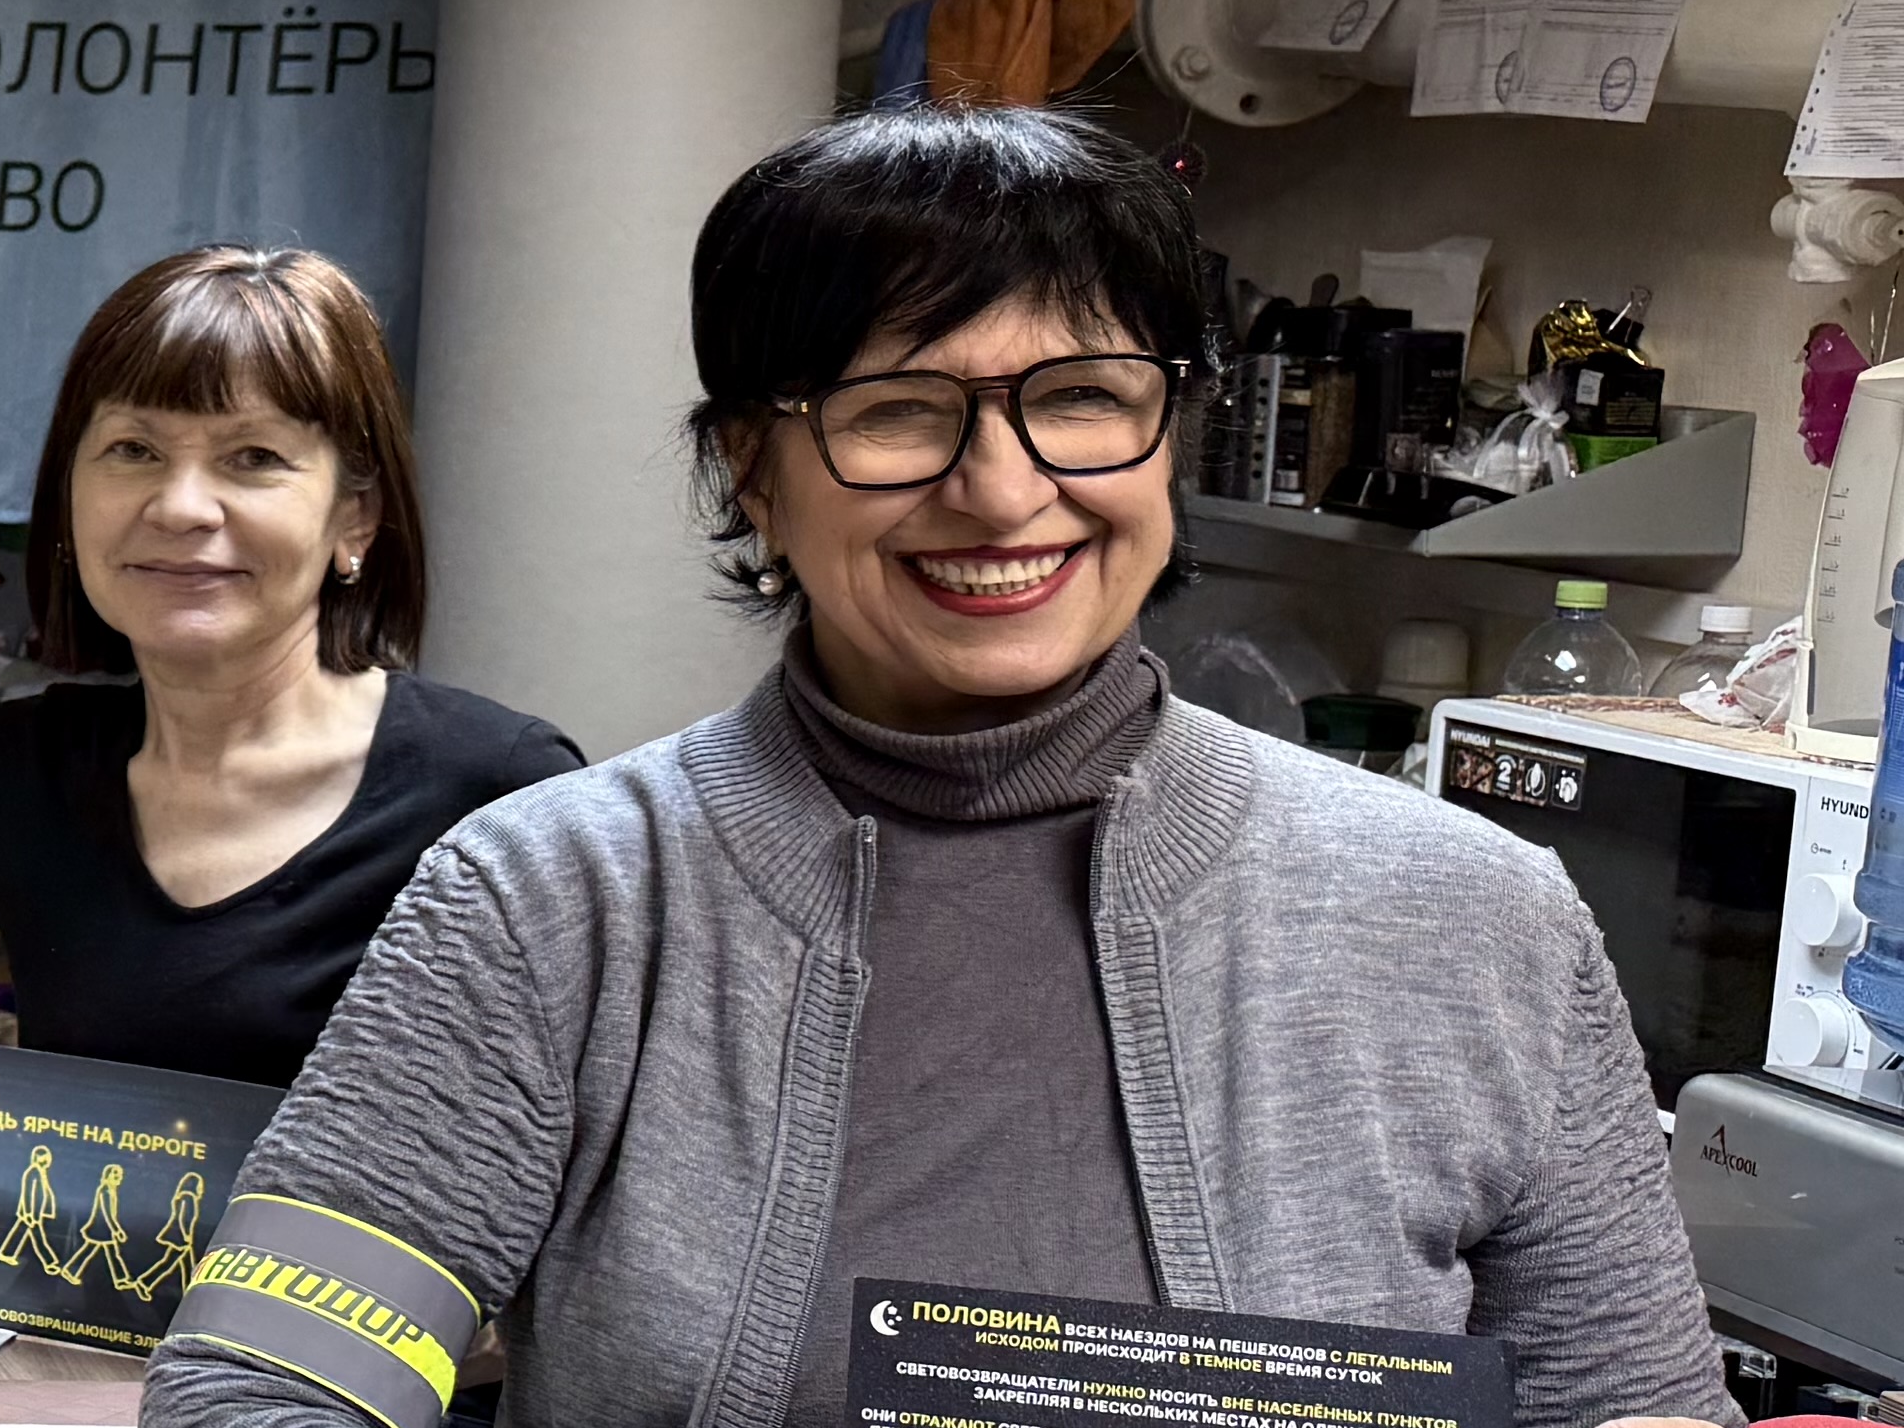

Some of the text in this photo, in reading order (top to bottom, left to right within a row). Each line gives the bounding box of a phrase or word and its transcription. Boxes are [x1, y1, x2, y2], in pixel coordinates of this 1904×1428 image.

[1820, 796, 1870, 819] HYUND
[23, 1116, 78, 1139] ЯРЧЕ
[83, 1125, 113, 1145] НА
[118, 1131, 207, 1160] ДОРОГЕ
[209, 1249, 426, 1349] АВТОДОР
[912, 1301, 1452, 1375] ПОЛОВИНА ВСЕХ НАЕЗДОВ НА ПЕШЕХОДОВ С ЛЕТАЛЬНЫМ
[976, 1331, 1383, 1385] ИСХОДОМ ПРОИСХОДИТ В ТЕМНОЕ ВРЕМЯ СУТОК
[861, 1408, 896, 1423] ОНИ
[896, 1361, 1080, 1393] СВЕТОВОЗВРАЩАТЕЛИ
[1083, 1381, 1146, 1399] НУЖНО
[1149, 1386, 1218, 1408] НОСИТЬ
[1221, 1396, 1254, 1411] ВНЕ
[1257, 1401, 1373, 1424] НАСЕЛЁННЫХ
[974, 1387, 1070, 1408] ЗАКРЕПЛЯЯ
[1073, 1398, 1084, 1410] В
[1087, 1399, 1198, 1422] НЕСКОЛЬКИХ
